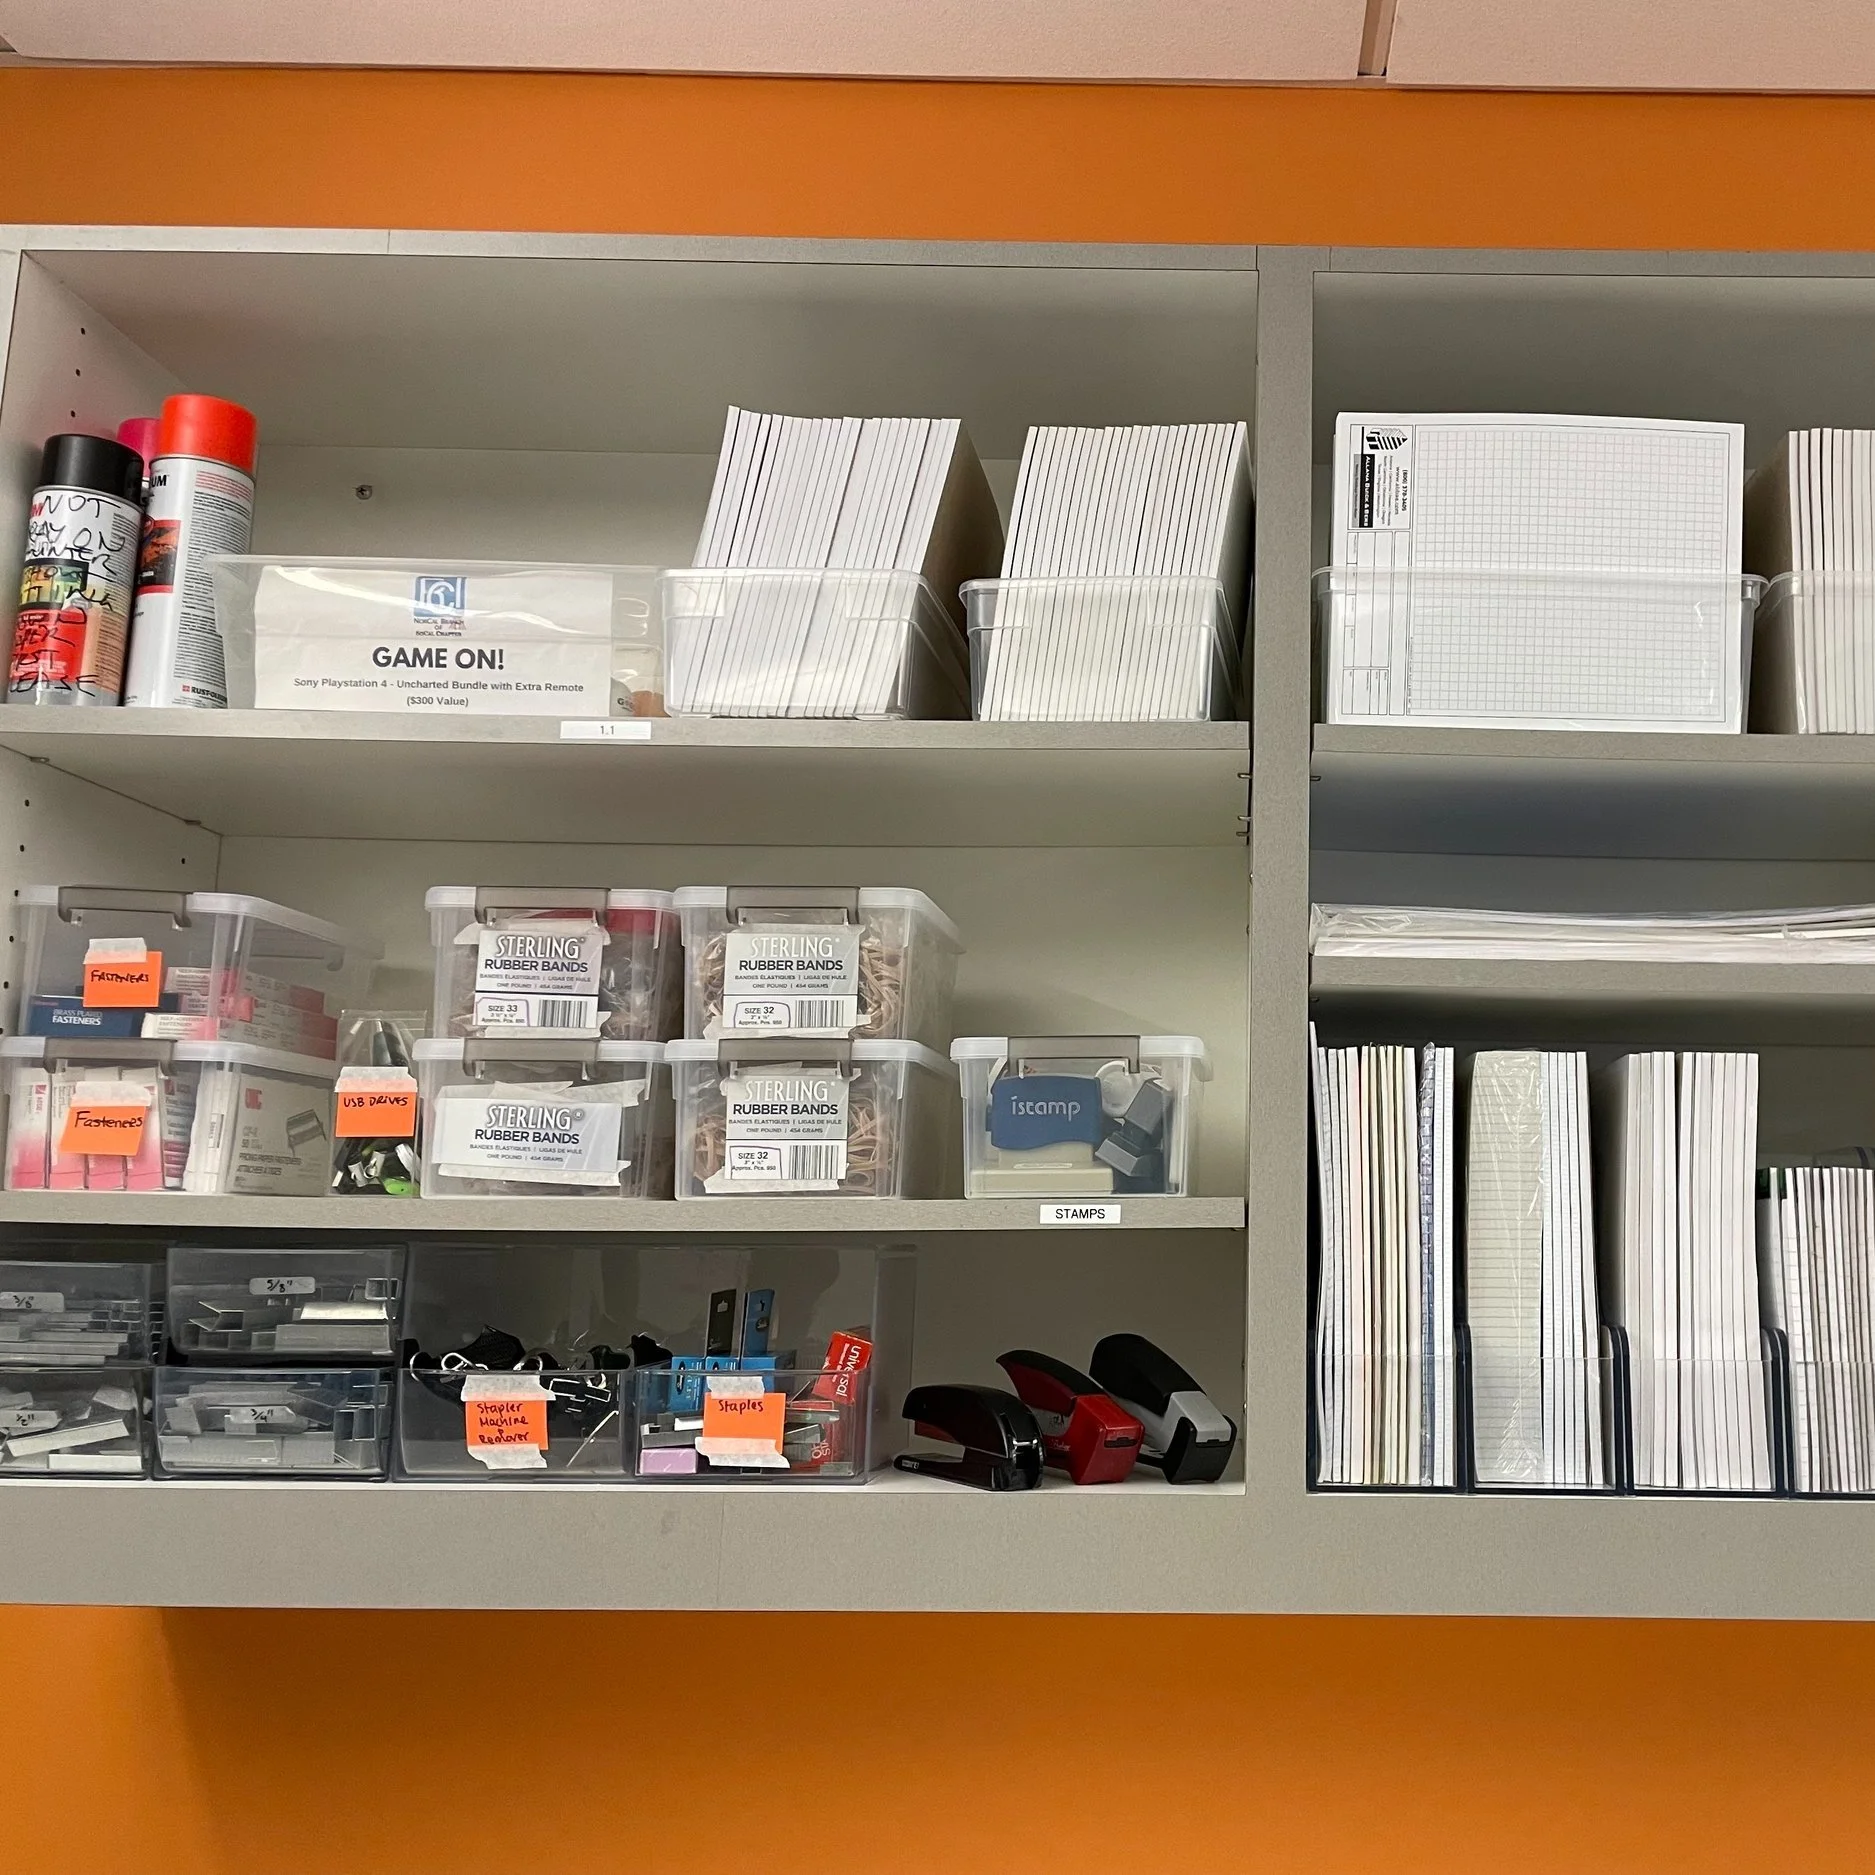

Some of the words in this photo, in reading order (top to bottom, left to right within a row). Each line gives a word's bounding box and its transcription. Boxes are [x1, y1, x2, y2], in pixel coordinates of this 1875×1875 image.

[42, 494, 122, 519] NOT
[372, 647, 448, 669] GAME
[454, 648, 504, 670] ON!
[293, 678, 319, 689] Sony
[321, 678, 378, 689] Playstation
[380, 679, 387, 688] 4
[396, 679, 449, 689] Uncharted
[451, 680, 488, 690] Bundle
[491, 681, 513, 691] with
[515, 682, 542, 692] Extra
[544, 683, 584, 692] Remote
[406, 696, 434, 707] ($300
[436, 695, 469, 707] Value)
[599, 725, 615, 735] 1.1
[495, 935, 580, 959] STERLING
[750, 936, 834, 958] STERLING
[484, 958, 538, 972] RUBBER
[540, 961, 589, 973] BANDS
[738, 959, 794, 971] RUBBER
[796, 960, 844, 971] BANDS
[90, 969, 150, 985] FASTENERS
[487, 1004, 505, 1012] SIZE
[506, 1004, 518, 1013] 33
[763, 1006, 775, 1014] 32
[51, 1015, 102, 1026] FASTENERS
[744, 1080, 829, 1102] STERLING
[343, 1096, 366, 1108] USB
[368, 1095, 409, 1107] DRIVES
[733, 1103, 788, 1115] RUBBER
[790, 1103, 839, 1115] BANDS
[1011, 1095, 1081, 1122] istamp
[74, 1110, 144, 1130] Fasteners
[486, 1105, 572, 1130] STERLING
[474, 1128, 530, 1142] RUBBER
[532, 1131, 580, 1144] BANDS
[757, 1151, 769, 1160] 32
[1055, 1208, 1106, 1220] STAMPS
[266, 1279, 293, 1293] 5/8"
[835, 1345, 862, 1397] universal
[476, 1402, 524, 1418] Stapler
[718, 1399, 764, 1415] Staples
[250, 1408, 274, 1423] 3/4"
[479, 1415, 529, 1428] Machine
